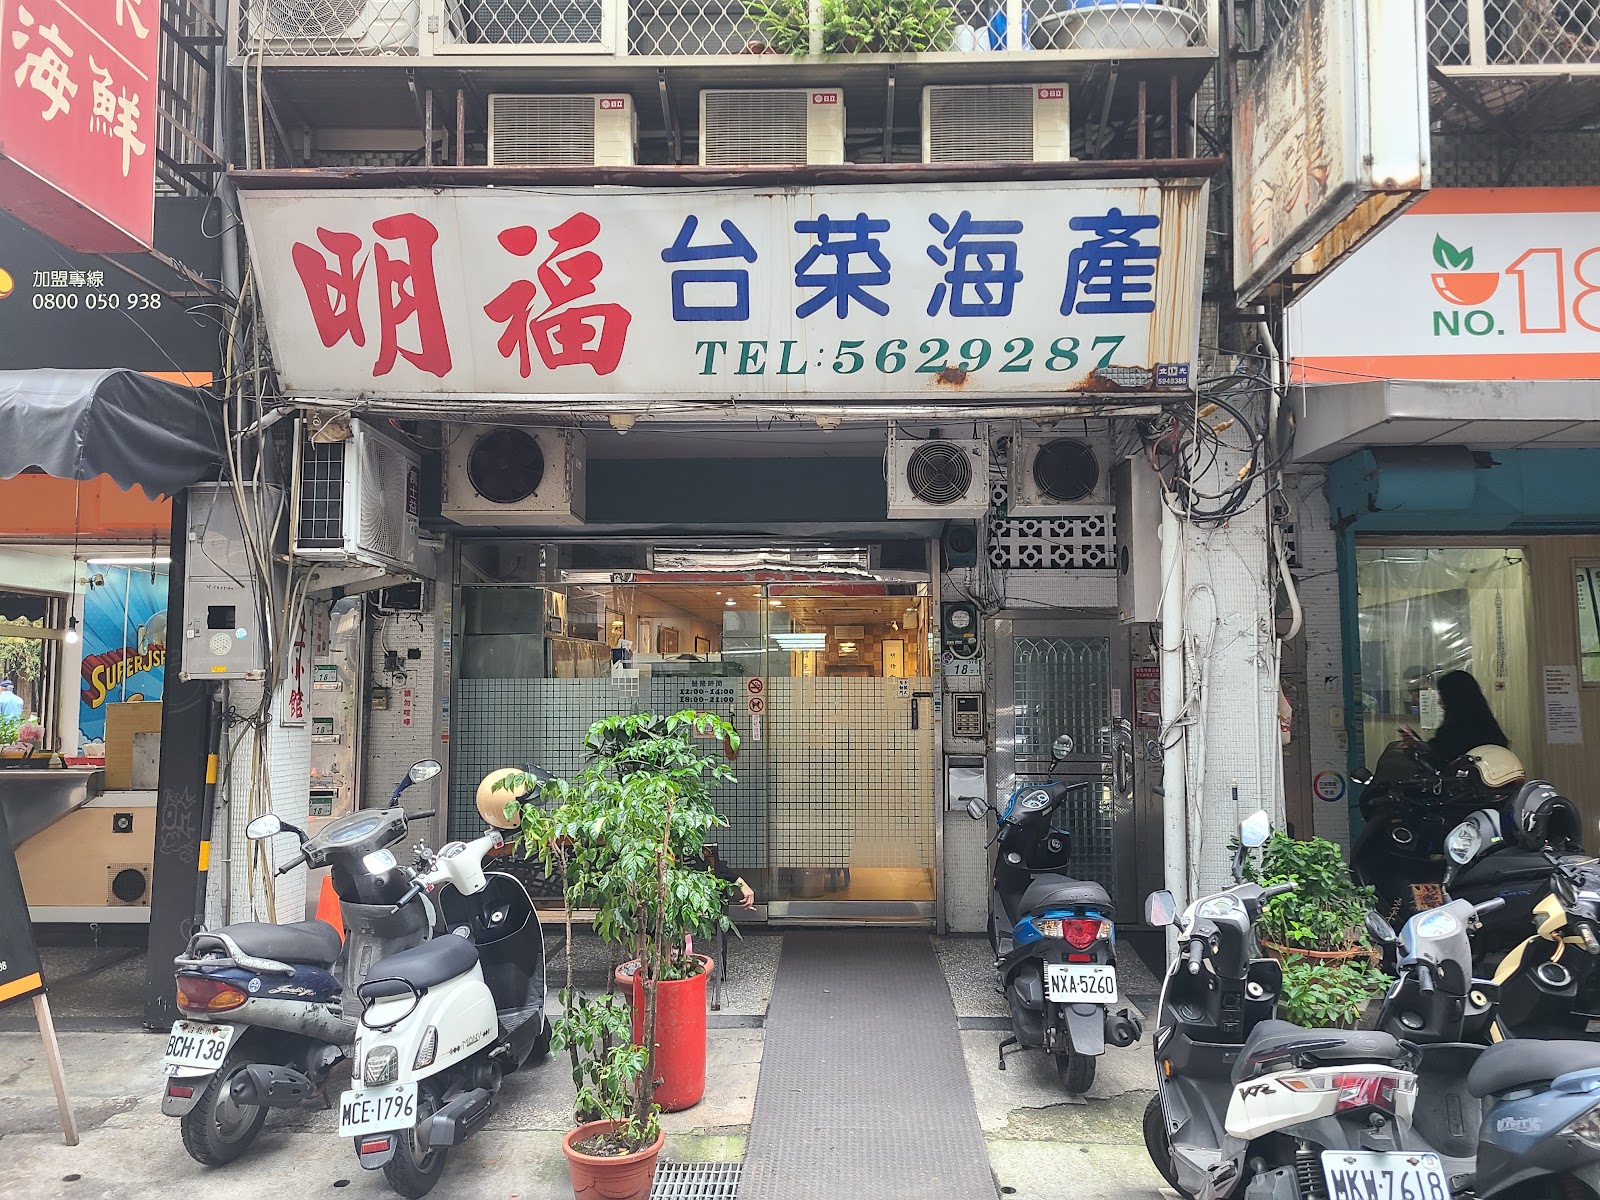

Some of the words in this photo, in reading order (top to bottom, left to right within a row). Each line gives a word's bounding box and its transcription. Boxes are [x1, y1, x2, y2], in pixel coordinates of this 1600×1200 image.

[11, 4, 147, 178] 海鮮
[32, 270, 104, 288] 加盟專線
[32, 293, 78, 310] 0800
[85, 293, 120, 310] 050
[127, 293, 161, 310] 938
[292, 212, 632, 378] 明福
[660, 207, 1161, 320] 台菜海產
[1433, 309, 1505, 336] NO.
[954, 664, 968, 674] 18
[1051, 974, 1114, 995] NXA-5260
[166, 1035, 225, 1061] BCH-138
[342, 1093, 414, 1126] MCE-1796
